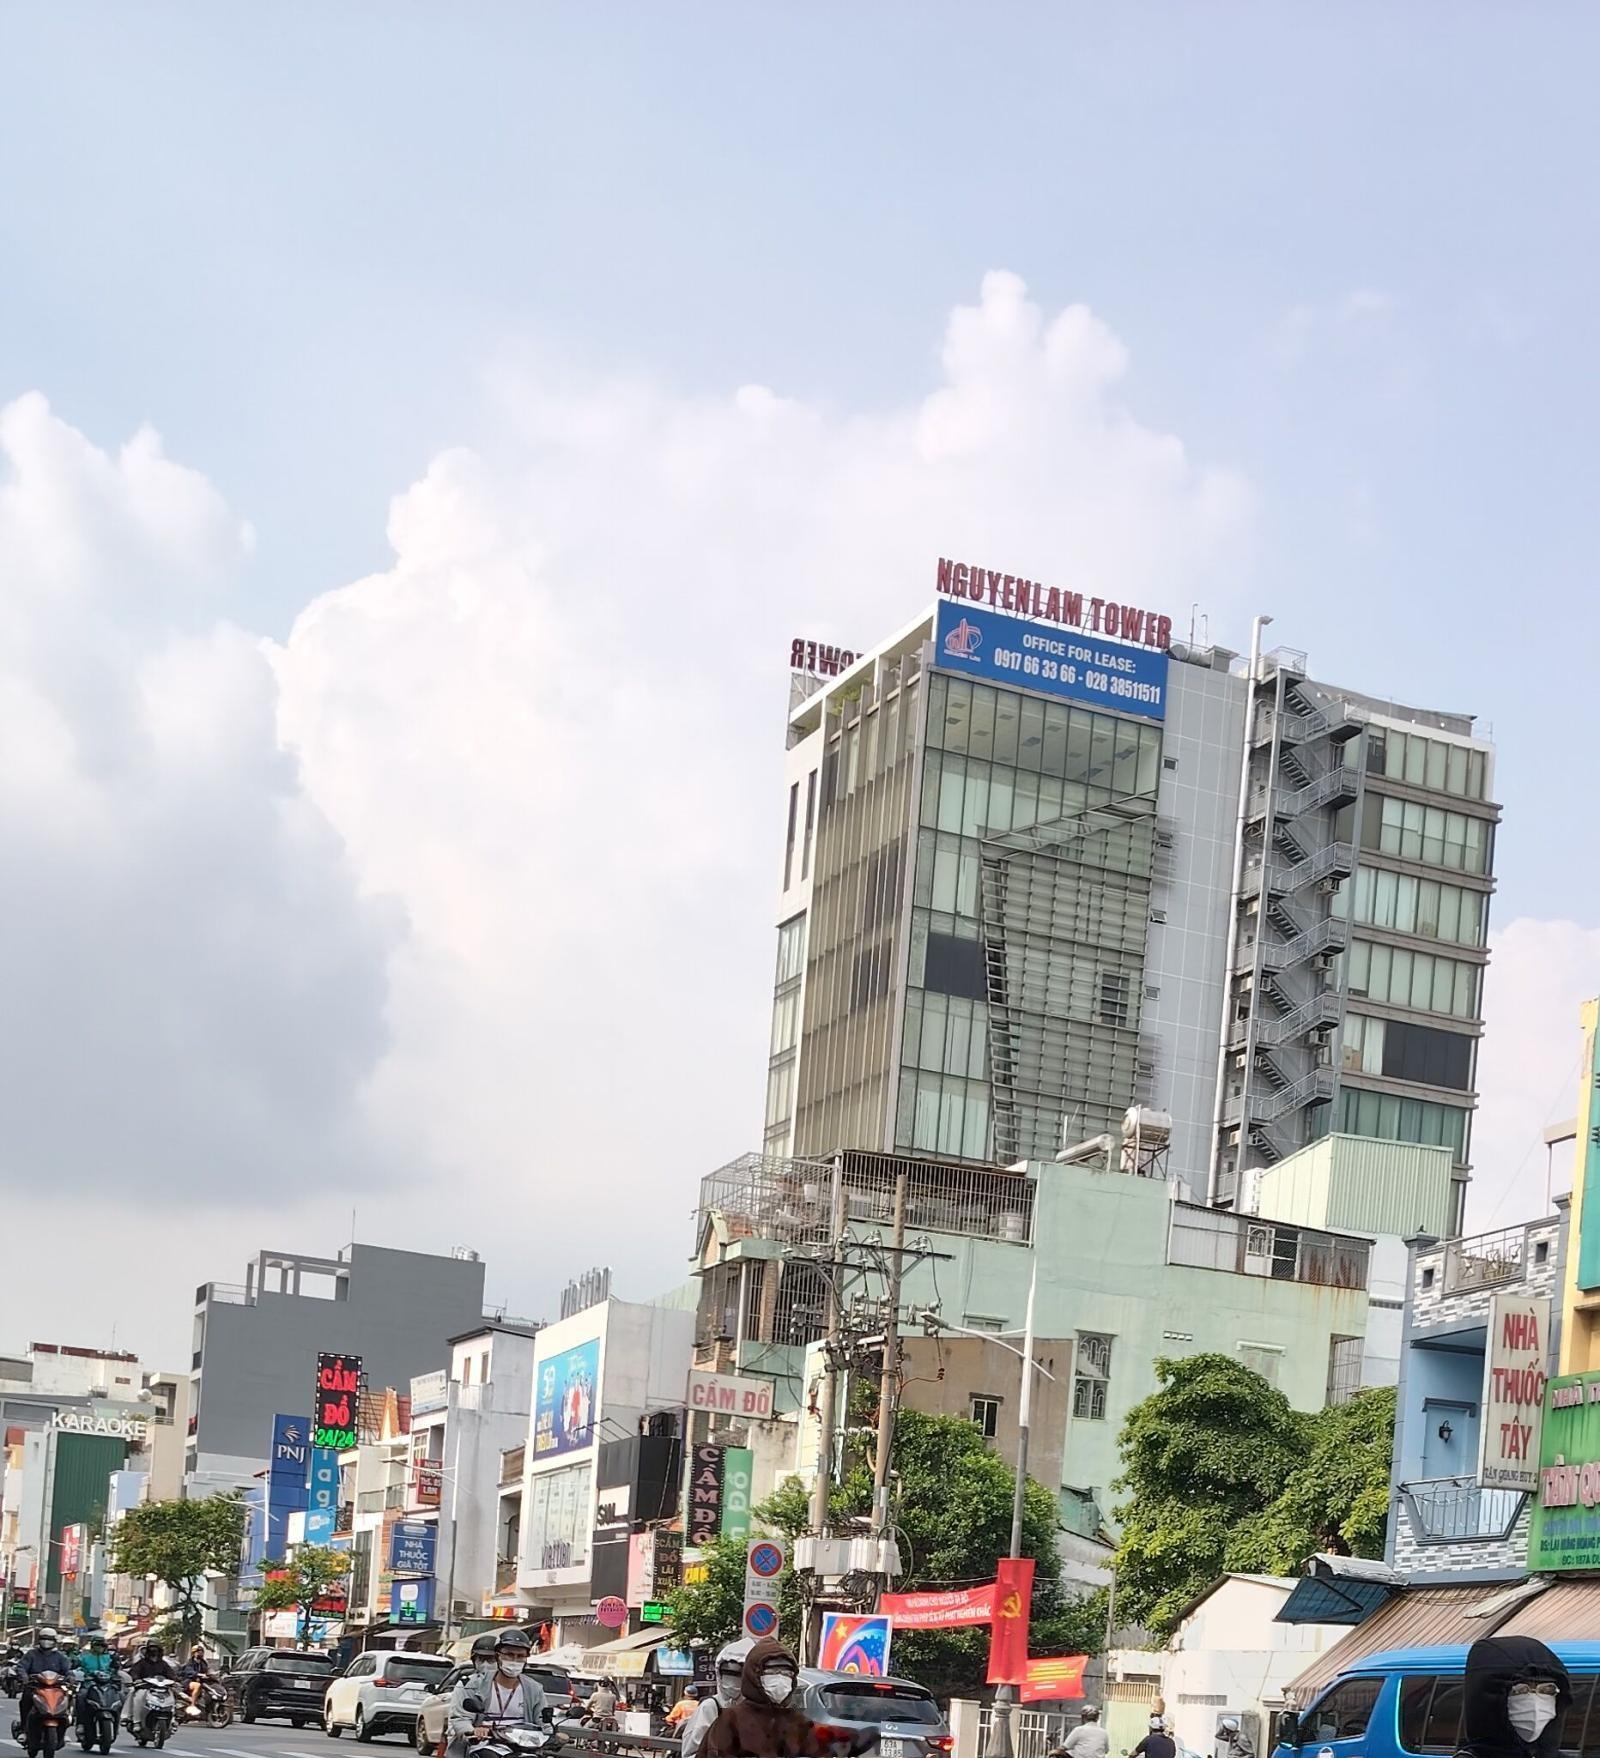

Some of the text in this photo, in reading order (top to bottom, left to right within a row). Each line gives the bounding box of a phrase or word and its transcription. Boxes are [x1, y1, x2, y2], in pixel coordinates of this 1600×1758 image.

[936, 557, 1173, 650] NGUYENLAM TOWER
[1023, 633, 1136, 674] OFFICE FOR LEASE:
[994, 648, 1021, 671] 0917
[1023, 656, 1040, 676] 66
[1042, 660, 1058, 680] 33
[1060, 665, 1076, 684] 66
[1085, 670, 1108, 692] 028
[1110, 675, 1161, 704] 38511511
[1503, 1307, 1539, 1351] NHÀ
[320, 1359, 357, 1393] CẦM
[1492, 1358, 1546, 1407] THUỐC
[323, 1394, 351, 1427] ĐỒ
[693, 1379, 770, 1415] CẦM ĐỒ
[52, 1412, 147, 1436] KARAOKE
[316, 1429, 355, 1448] 24/24
[1501, 1416, 1533, 1461] TÂY
[277, 1445, 306, 1464] PNJ
